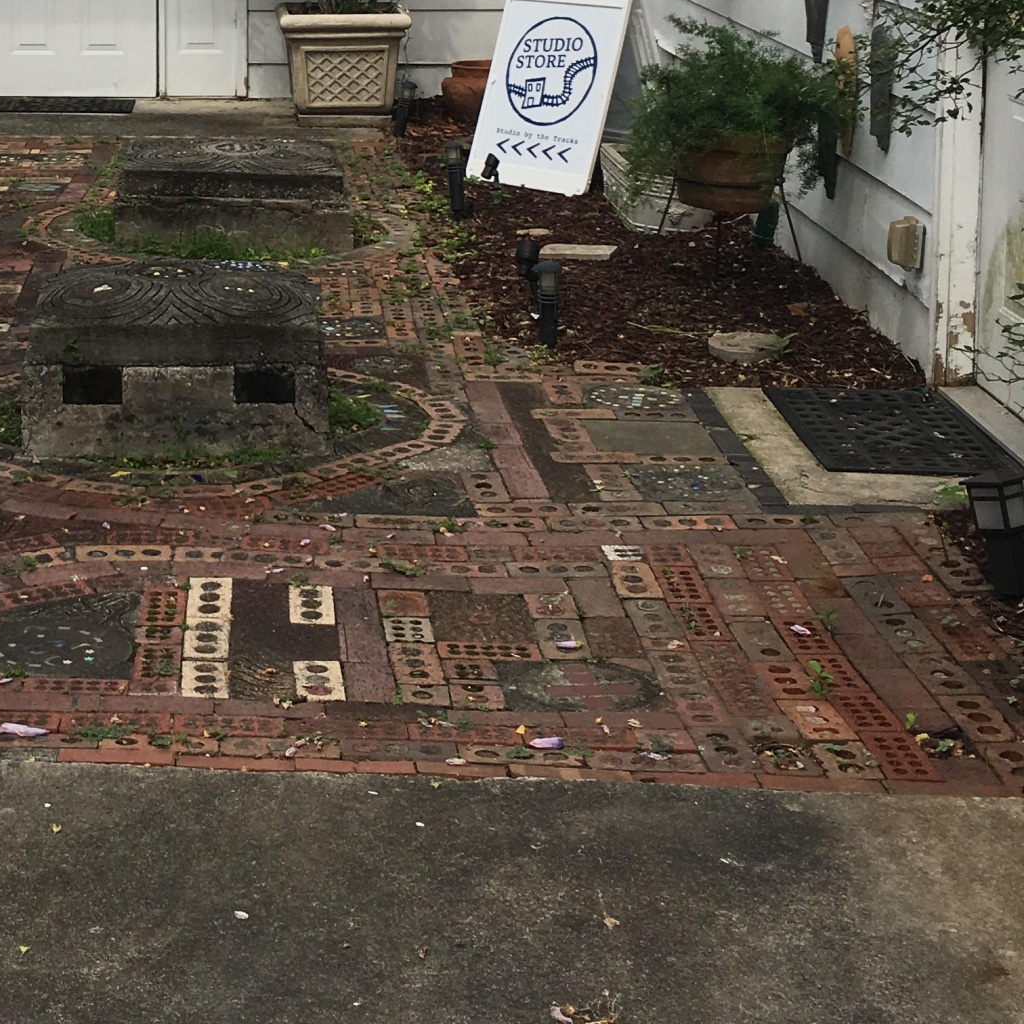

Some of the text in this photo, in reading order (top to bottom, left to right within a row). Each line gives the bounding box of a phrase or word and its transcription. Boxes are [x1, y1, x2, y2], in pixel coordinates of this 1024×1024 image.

[523, 37, 584, 53] STUDIO
[515, 54, 567, 69] STORE
[496, 127, 579, 145] Studio by the Tracks
